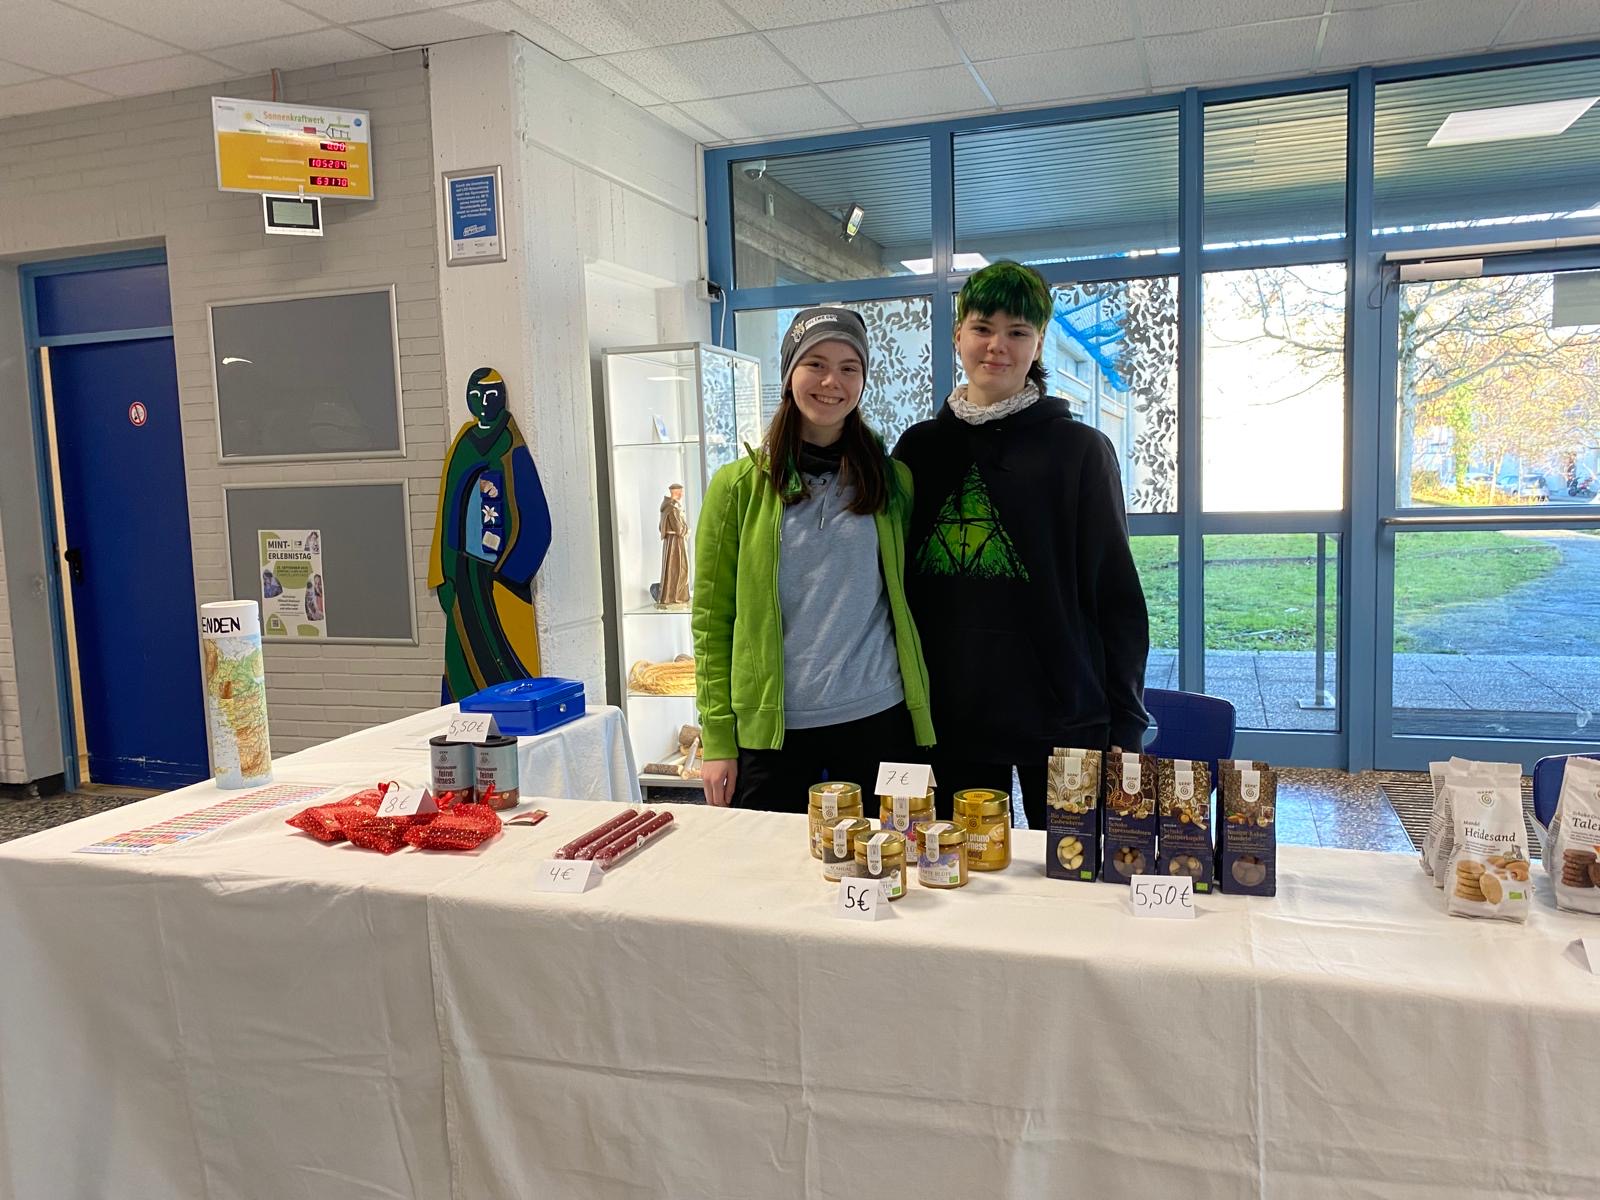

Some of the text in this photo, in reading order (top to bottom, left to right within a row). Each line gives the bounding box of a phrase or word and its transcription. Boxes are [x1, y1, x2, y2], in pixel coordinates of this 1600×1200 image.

[263, 111, 325, 125] Sonnenkraftwerk
[267, 540, 291, 549] MINT-
[268, 552, 312, 560] ERLEBNISTAG
[449, 720, 484, 737] 5,50€
[1464, 827, 1517, 843] Heidesand
[550, 867, 576, 882] 4€
[844, 885, 870, 912] 5€
[1135, 883, 1193, 909] 5,50€
